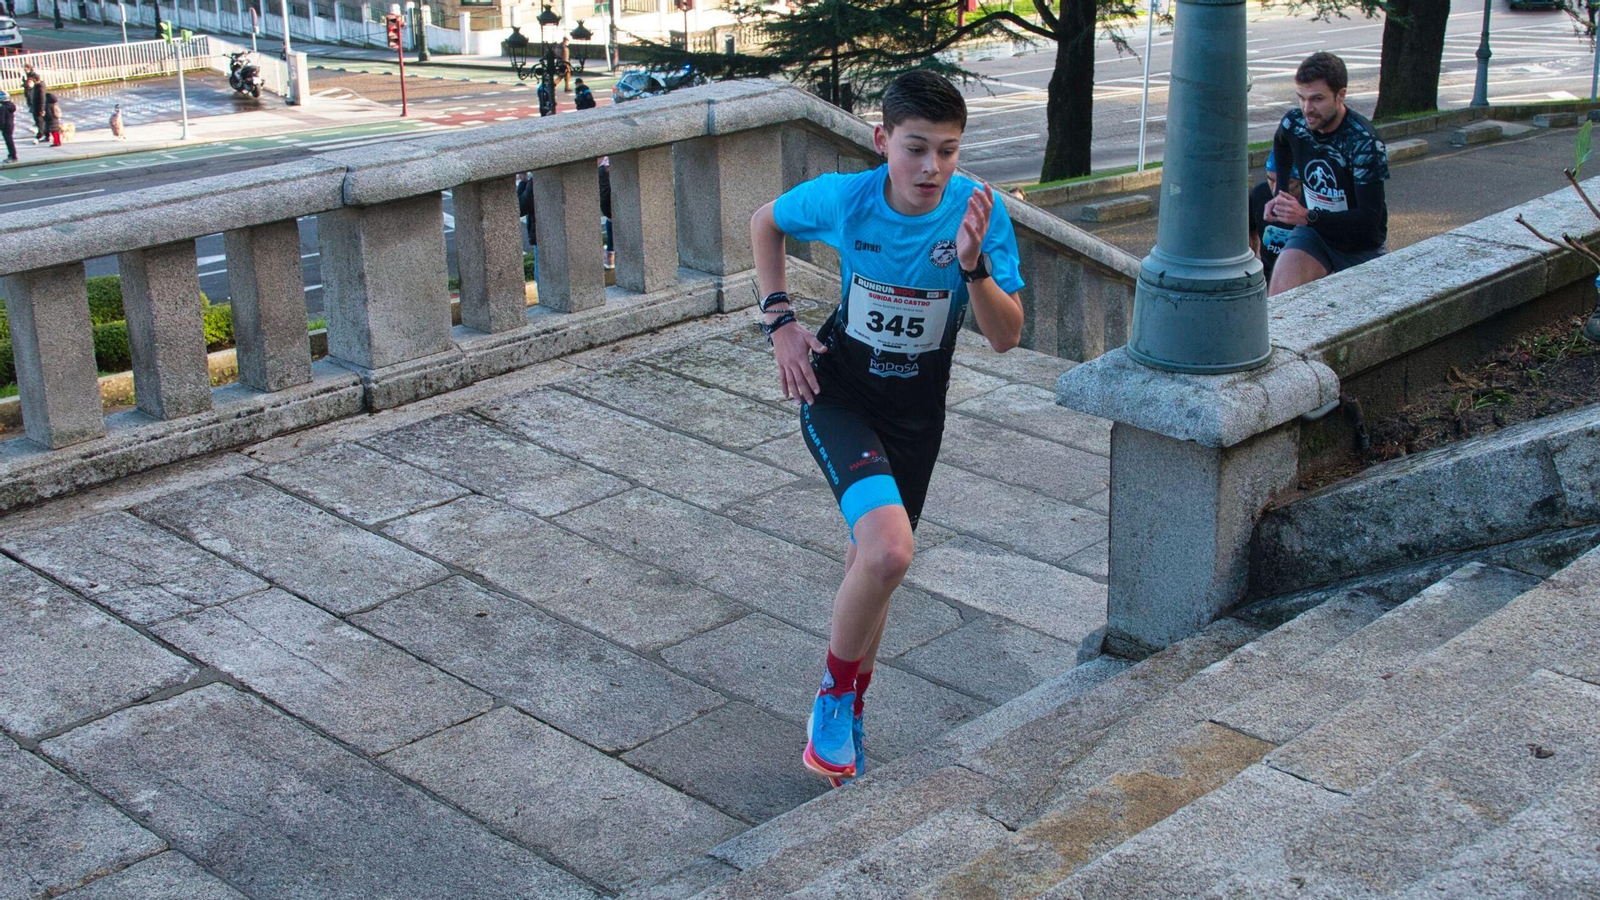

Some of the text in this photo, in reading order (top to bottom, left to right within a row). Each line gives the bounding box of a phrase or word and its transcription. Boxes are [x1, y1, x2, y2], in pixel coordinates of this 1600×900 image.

[868, 292, 892, 303] SUBIDA
[904, 299, 930, 307] CASTRO
[866, 310, 925, 339] 345
[807, 424, 821, 446] MAR
[819, 446, 828, 461] DE
[826, 460, 839, 485] VIGO
